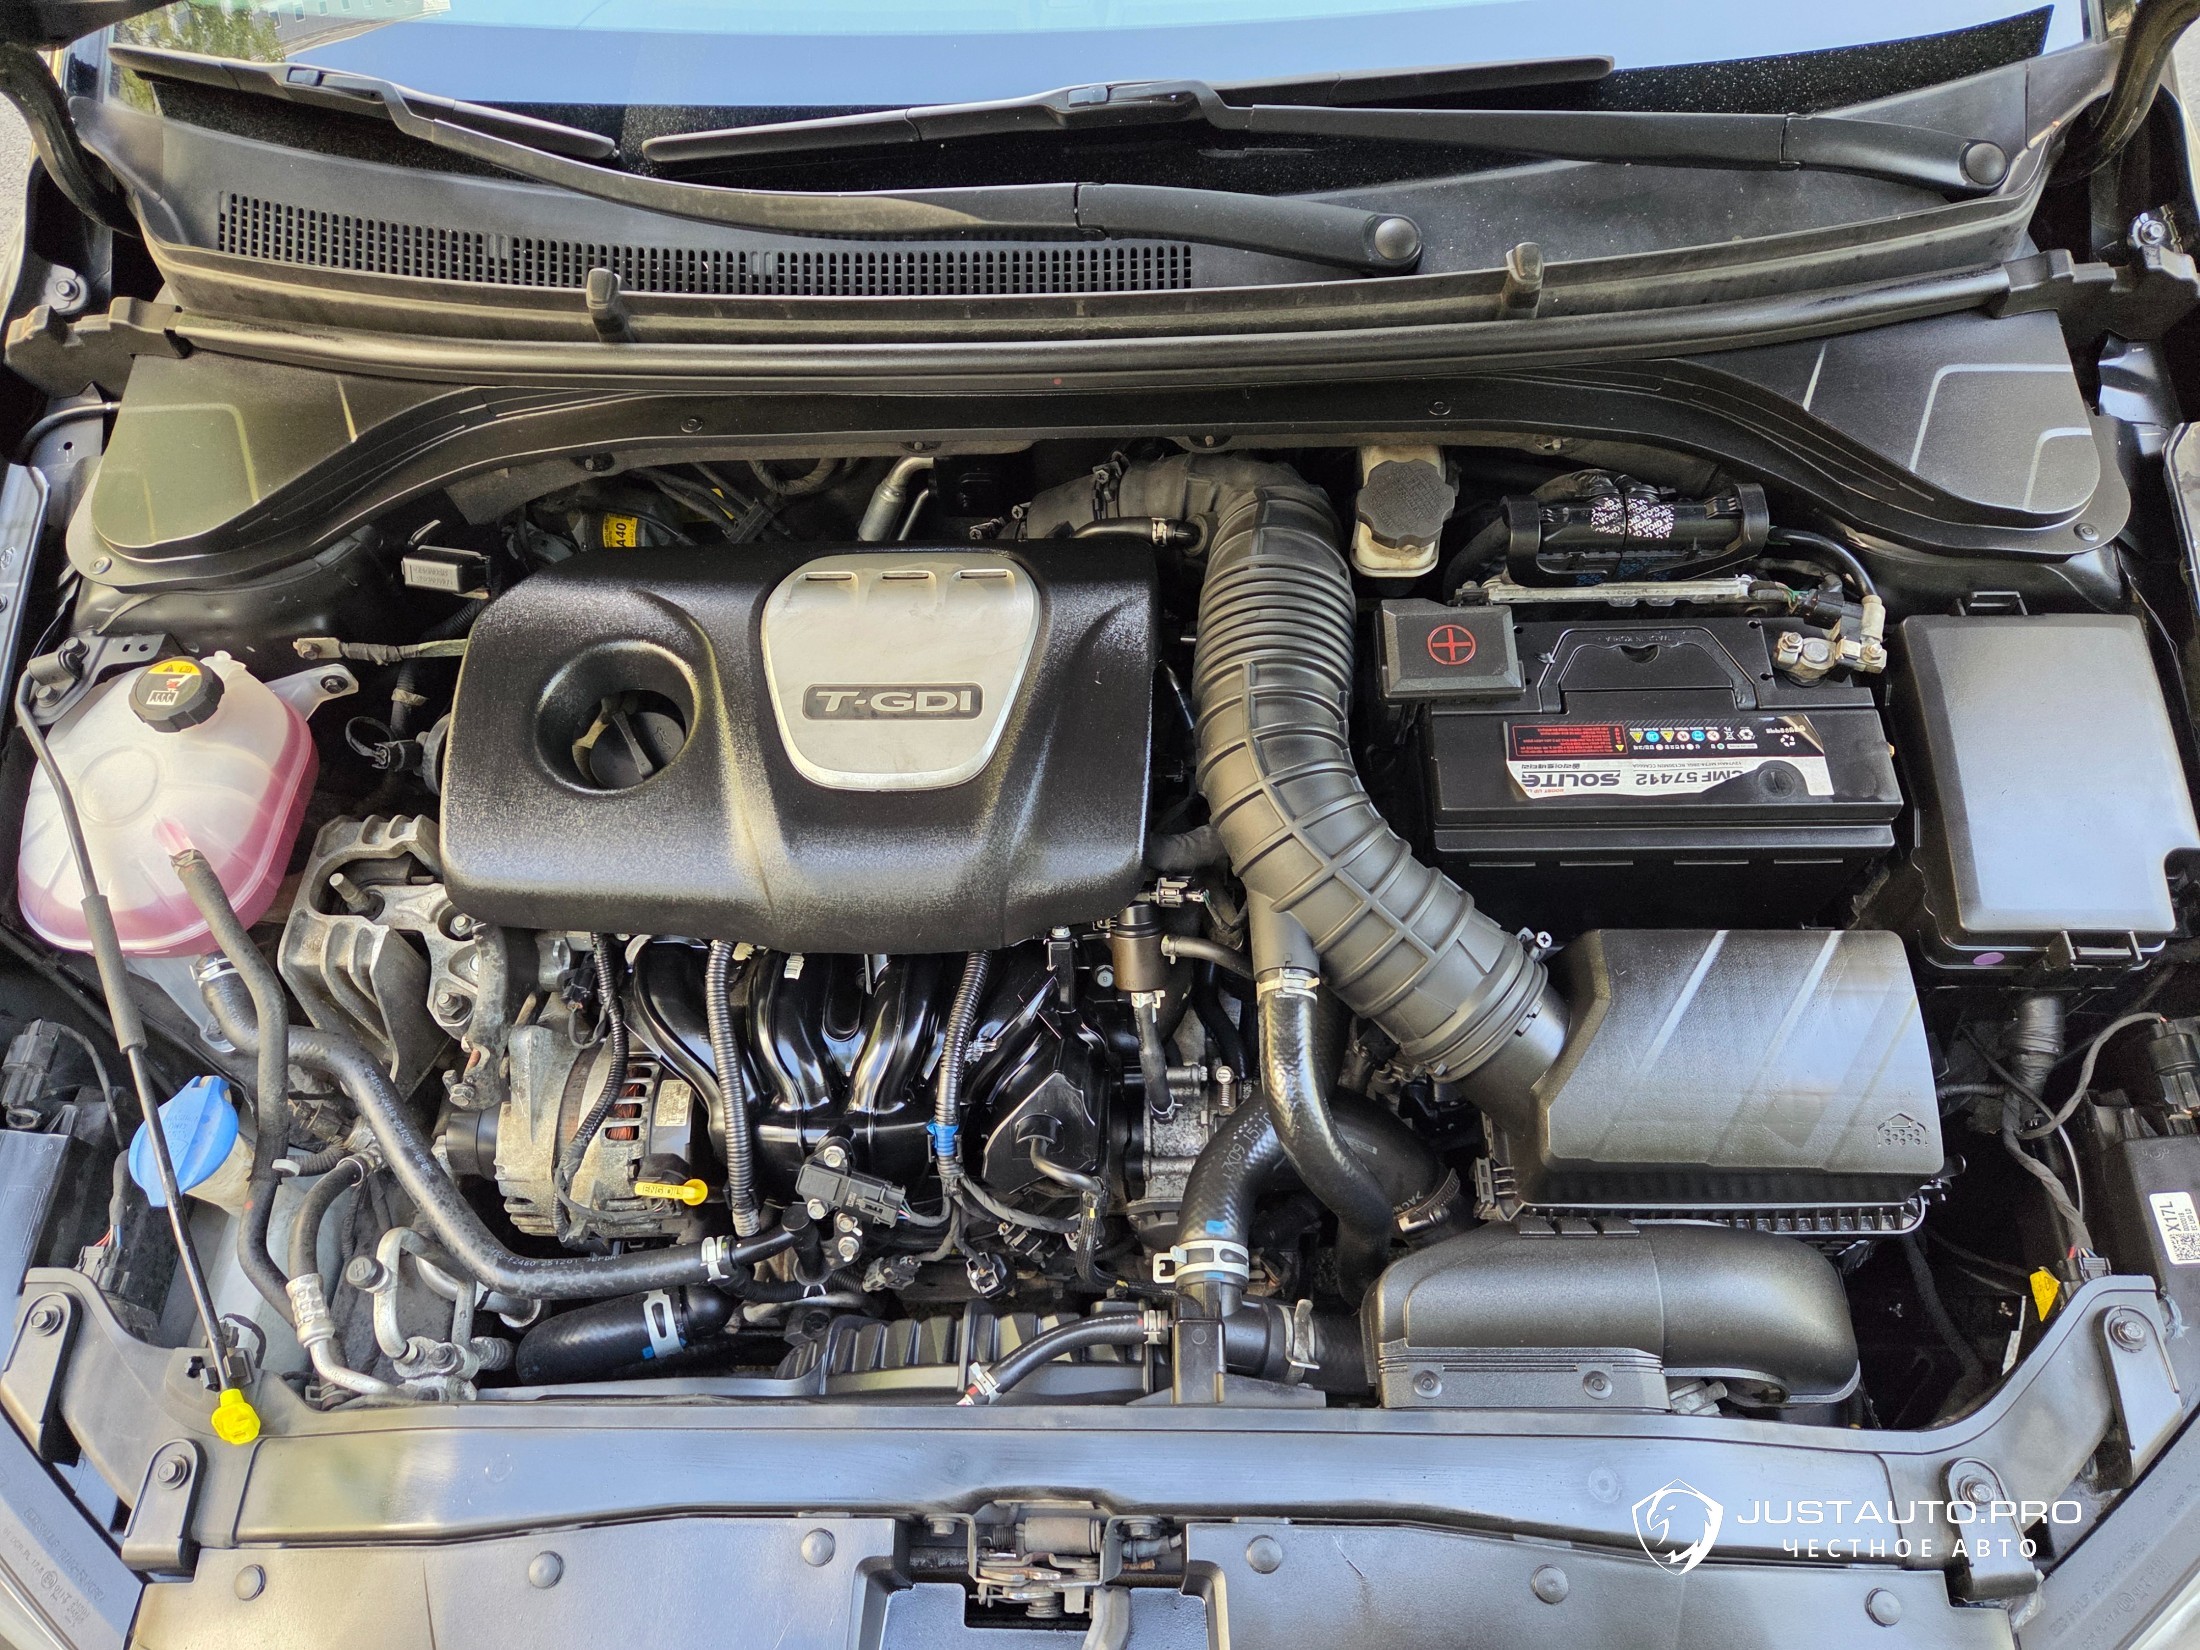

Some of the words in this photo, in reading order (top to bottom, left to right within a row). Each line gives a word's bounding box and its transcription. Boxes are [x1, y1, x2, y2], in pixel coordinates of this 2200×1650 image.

[1640, 506, 1660, 518] VOID
[1632, 517, 1652, 530] VOID
[1642, 520, 1663, 534] VOID
[1653, 522, 1674, 536] VOID
[816, 690, 972, 712] T-GDI
[1522, 774, 1620, 788] SOLITE
[1636, 772, 1698, 786] 57412
[364, 1065, 398, 1118] 25450-F2460
[394, 1118, 416, 1148] 251201
[643, 1184, 663, 1194] ENG
[2159, 1201, 2181, 1232] X17L
